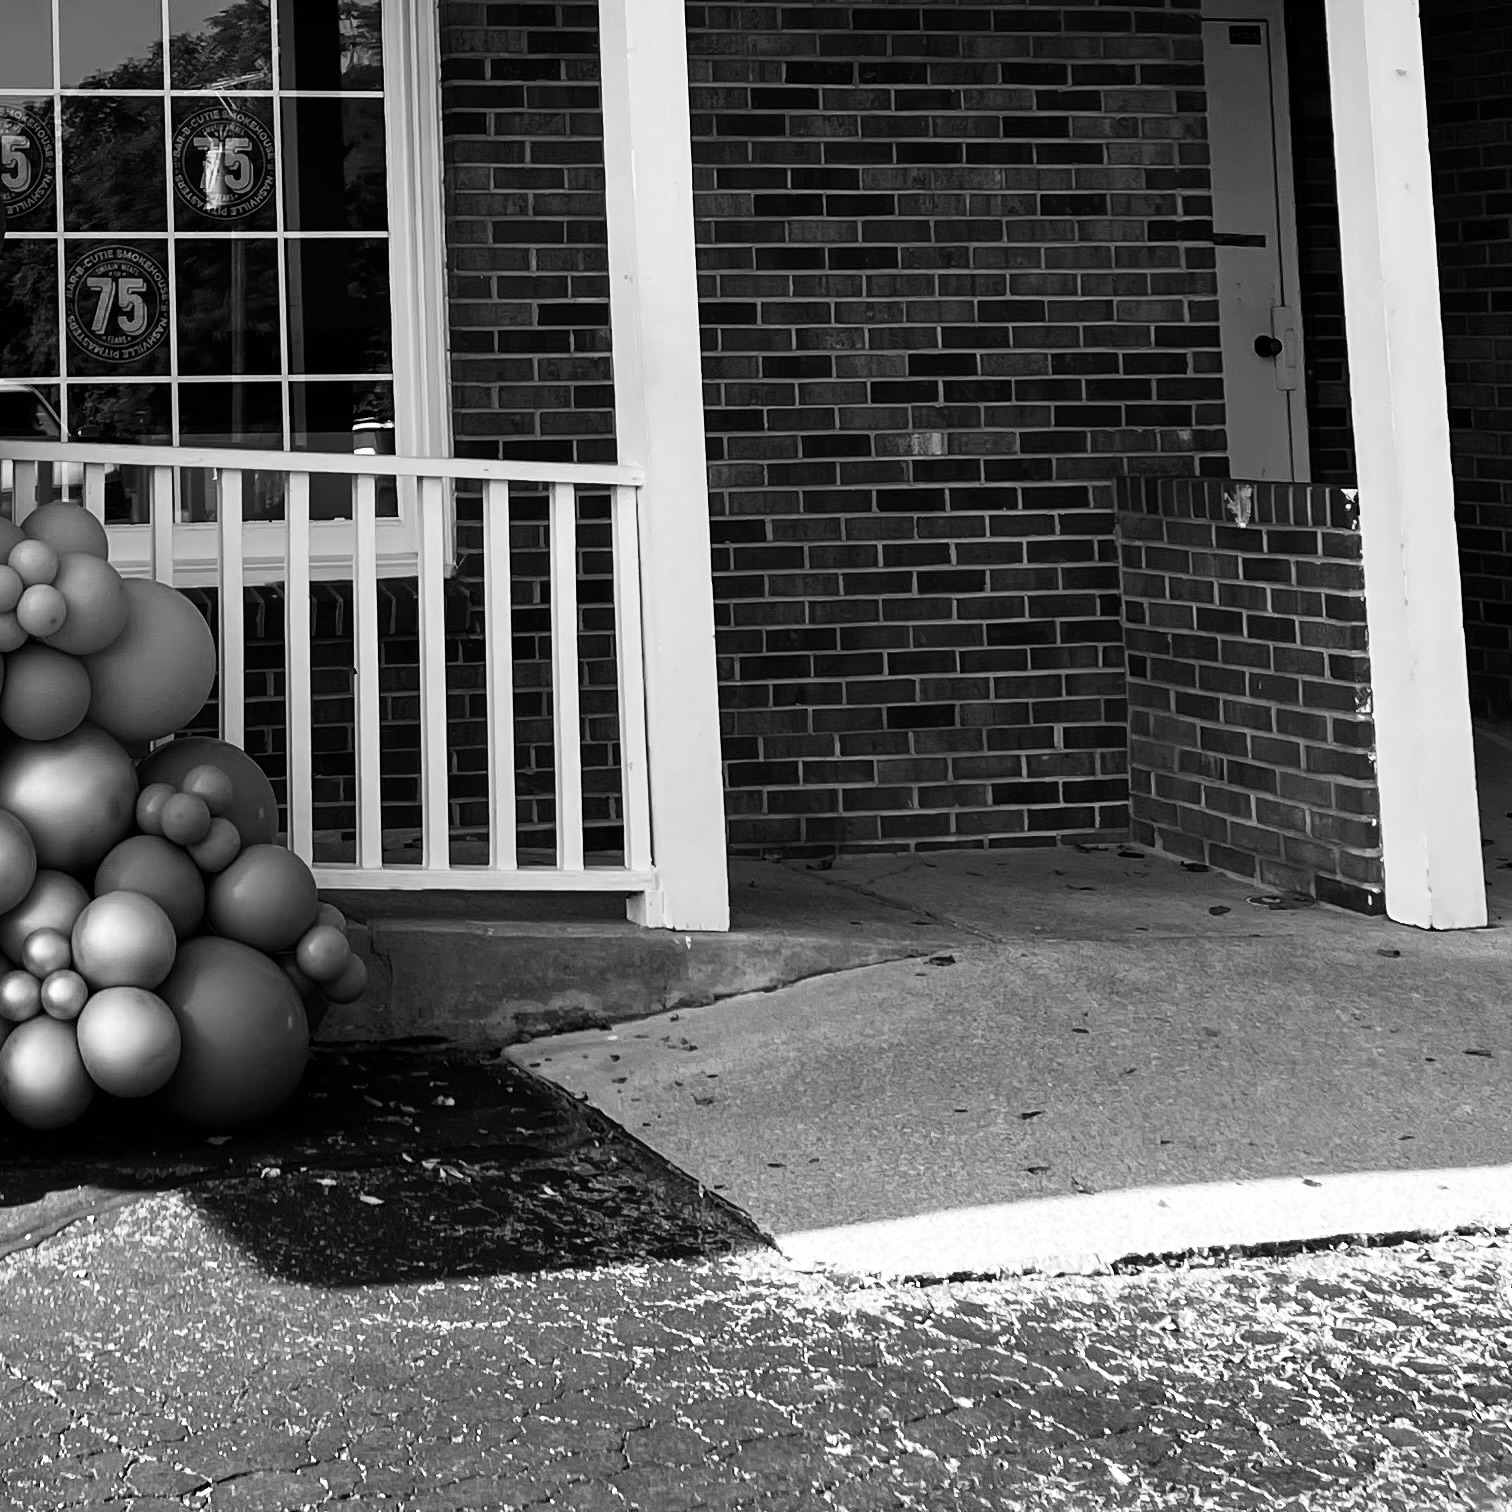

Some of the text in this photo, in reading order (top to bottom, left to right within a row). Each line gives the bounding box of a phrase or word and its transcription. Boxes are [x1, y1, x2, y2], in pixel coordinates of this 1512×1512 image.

[230, 175, 274, 215] NASHVILLE
[116, 249, 168, 301] SMOKEHOUSE
[86, 277, 148, 336] 75
[67, 315, 168, 359] NASHVILLE PITMASTERS
